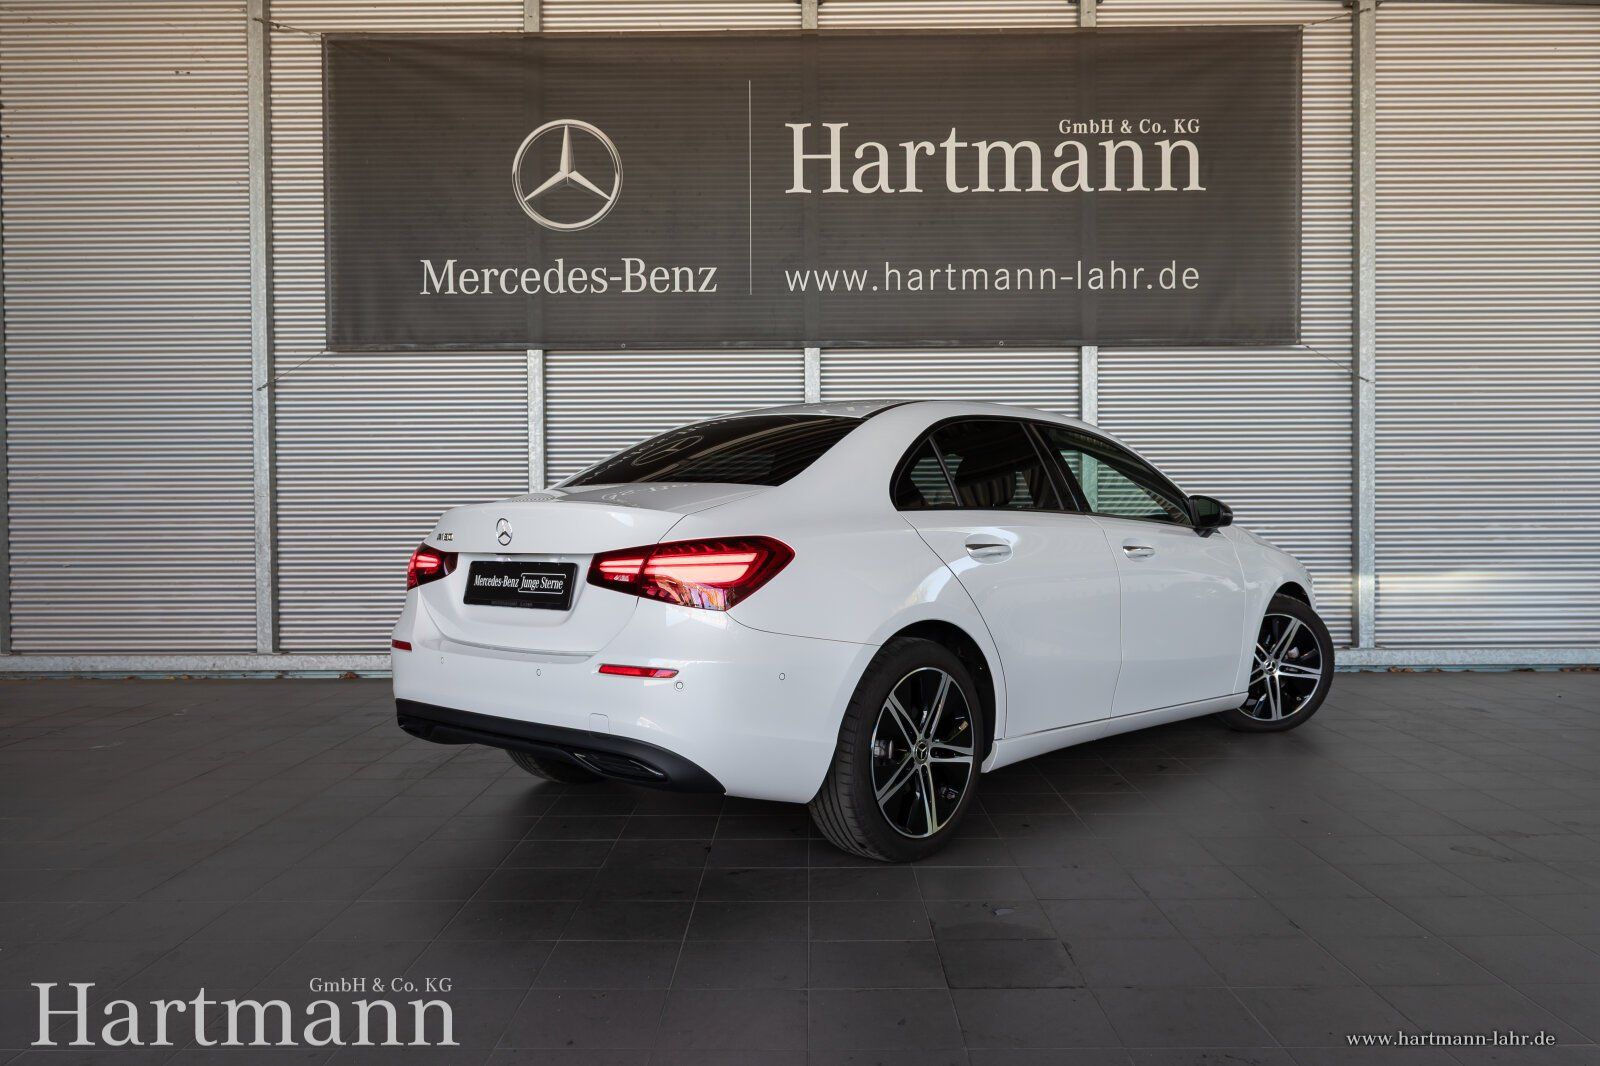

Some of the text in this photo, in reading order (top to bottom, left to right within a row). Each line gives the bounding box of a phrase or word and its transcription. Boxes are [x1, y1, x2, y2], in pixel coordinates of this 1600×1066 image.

[1058, 118, 1200, 135] GmbH & Co. KG
[784, 122, 1207, 194] Hartmann
[419, 257, 718, 295] Mercedes-Benz
[784, 260, 1200, 292] www.hartmann-lahr.de
[473, 574, 564, 591] Mercedes-Benz Junge Sterne
